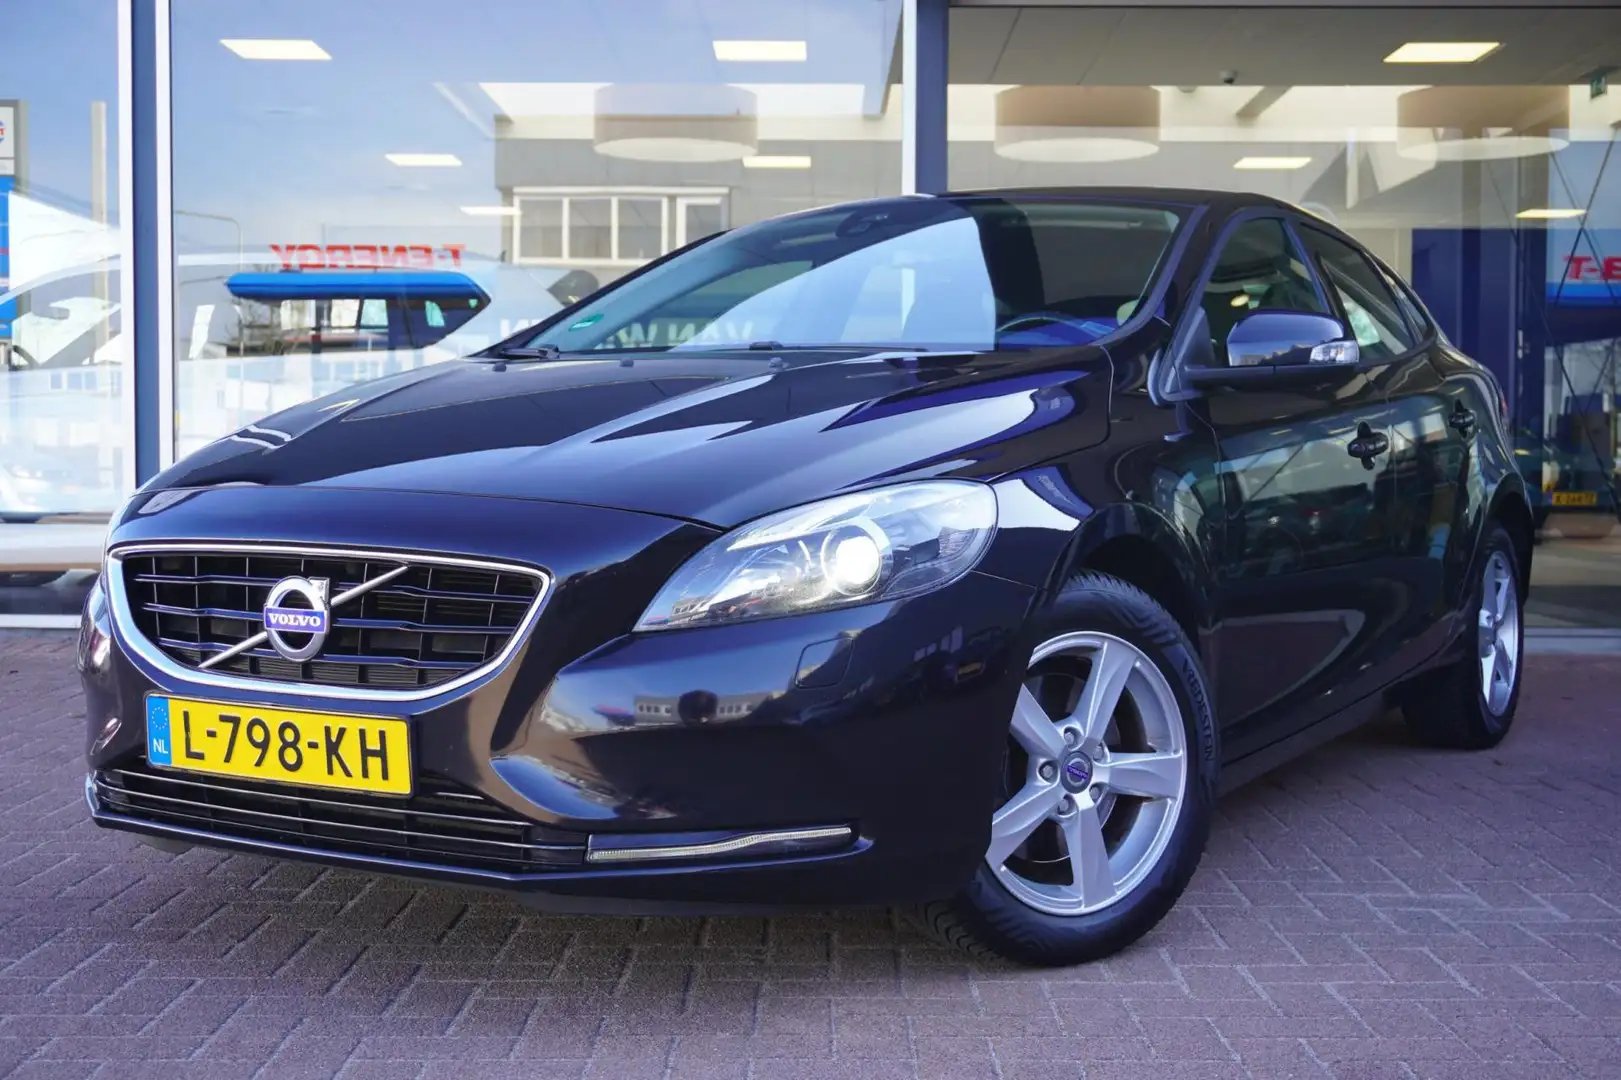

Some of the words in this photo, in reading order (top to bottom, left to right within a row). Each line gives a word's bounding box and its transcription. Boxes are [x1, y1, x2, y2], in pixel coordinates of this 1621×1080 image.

[267, 611, 322, 629] VOLVO
[152, 738, 169, 755] NL
[182, 710, 390, 781] L-798-KH
